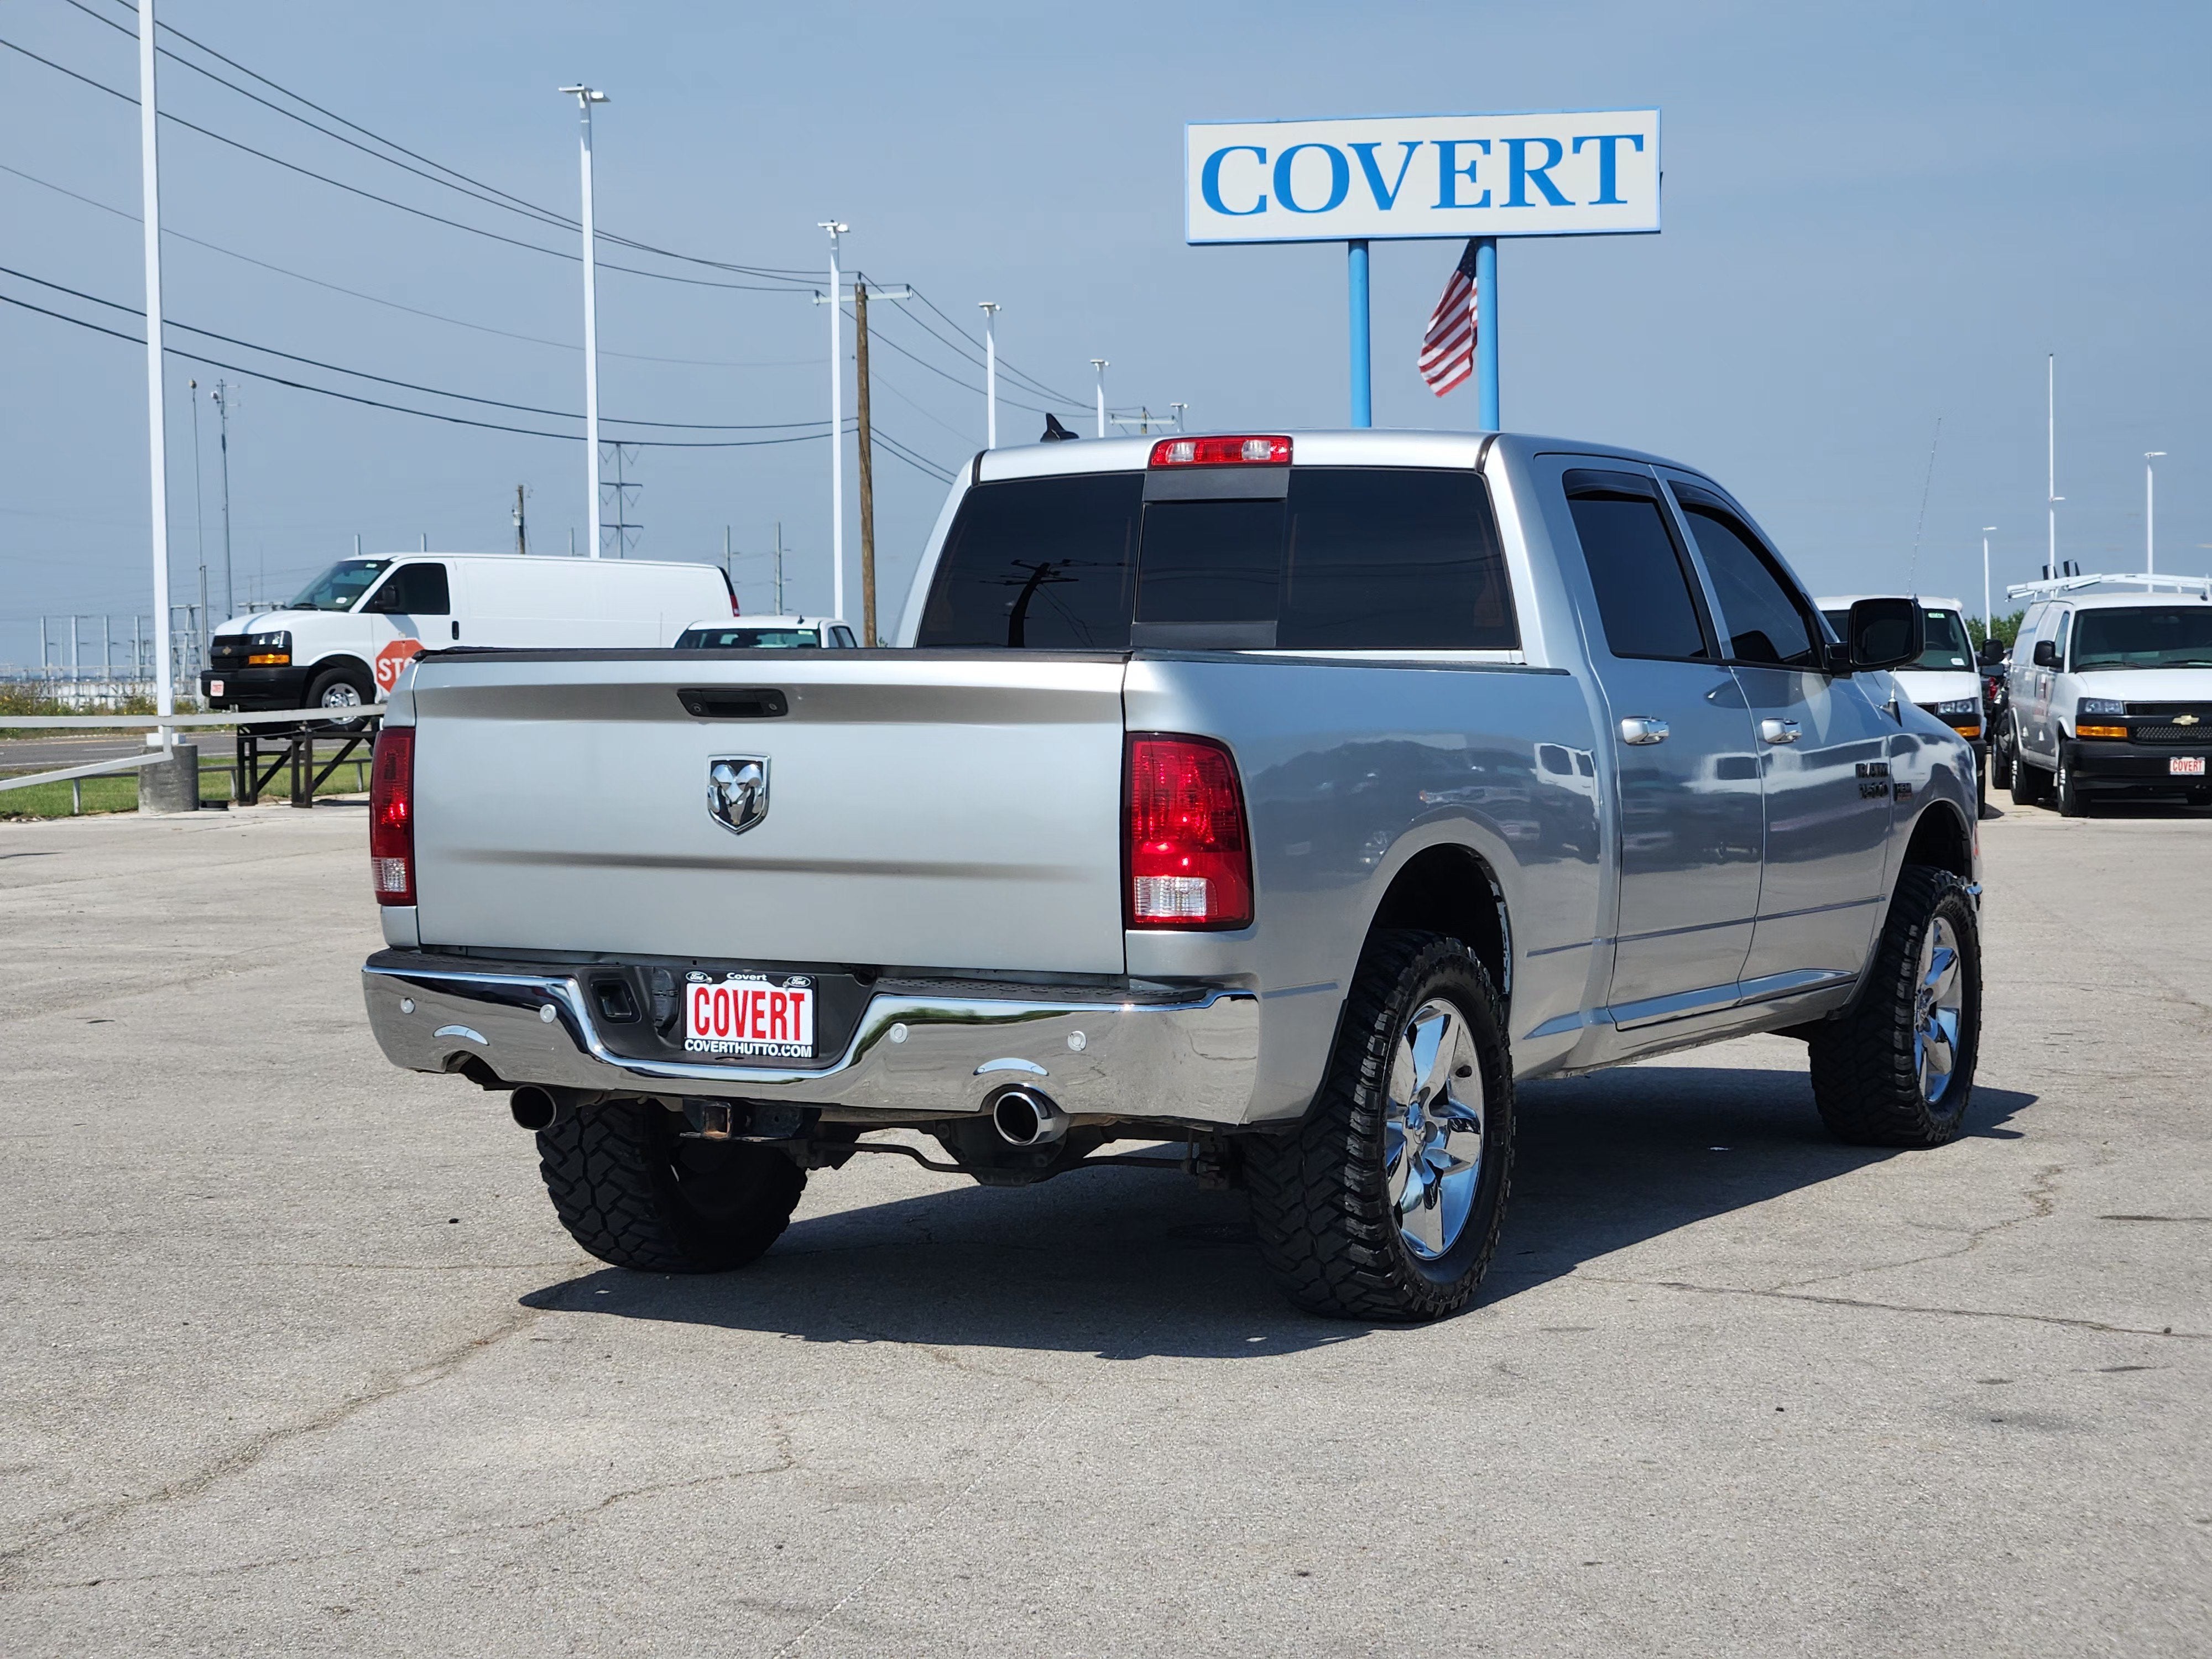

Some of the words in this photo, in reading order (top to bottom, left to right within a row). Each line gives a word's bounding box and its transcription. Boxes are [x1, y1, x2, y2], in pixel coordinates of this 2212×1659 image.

[1201, 134, 1644, 216] COVERT
[2173, 760, 2202, 771] COVERT
[726, 972, 768, 981] Covert
[695, 987, 805, 1041] COVERT
[685, 1039, 812, 1057] COVERTHUTTO.COM
